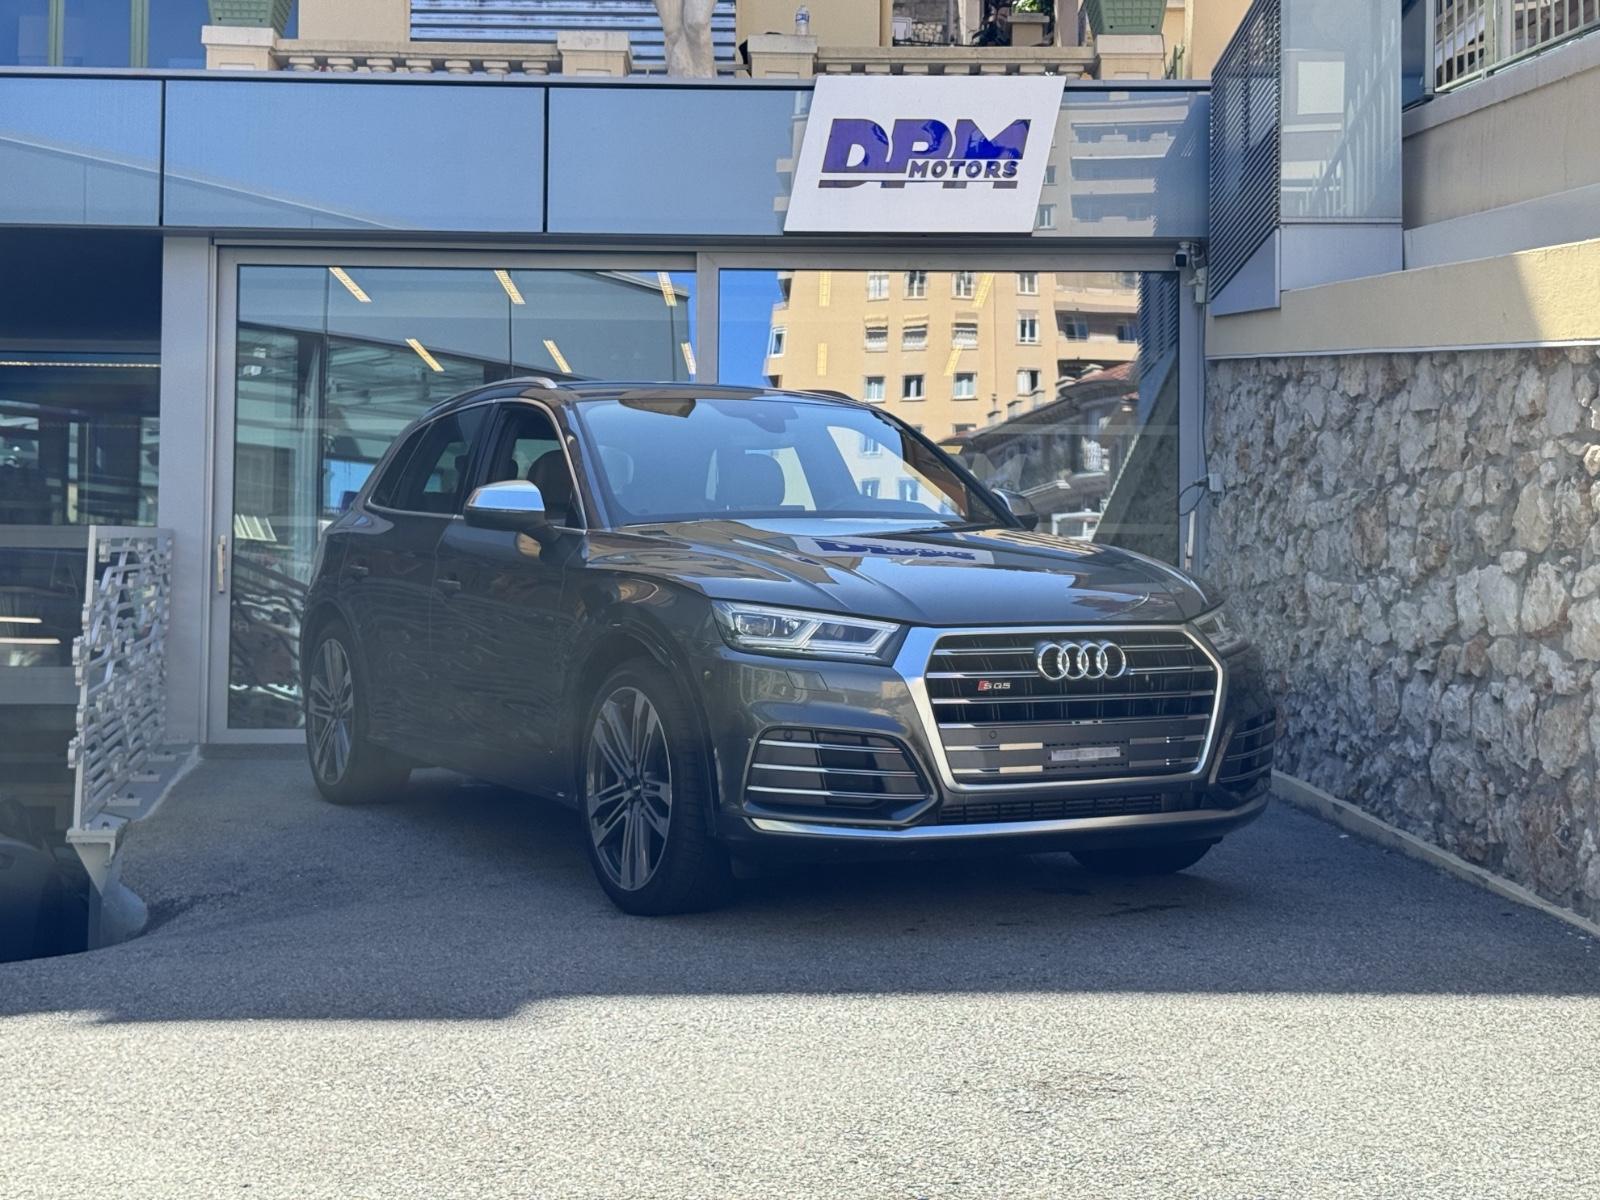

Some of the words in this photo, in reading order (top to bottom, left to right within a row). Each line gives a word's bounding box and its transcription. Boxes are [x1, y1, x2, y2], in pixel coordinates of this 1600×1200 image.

[819, 118, 1032, 188] DPM
[908, 160, 1019, 179] MOTORS
[977, 680, 1011, 691] SQ5
